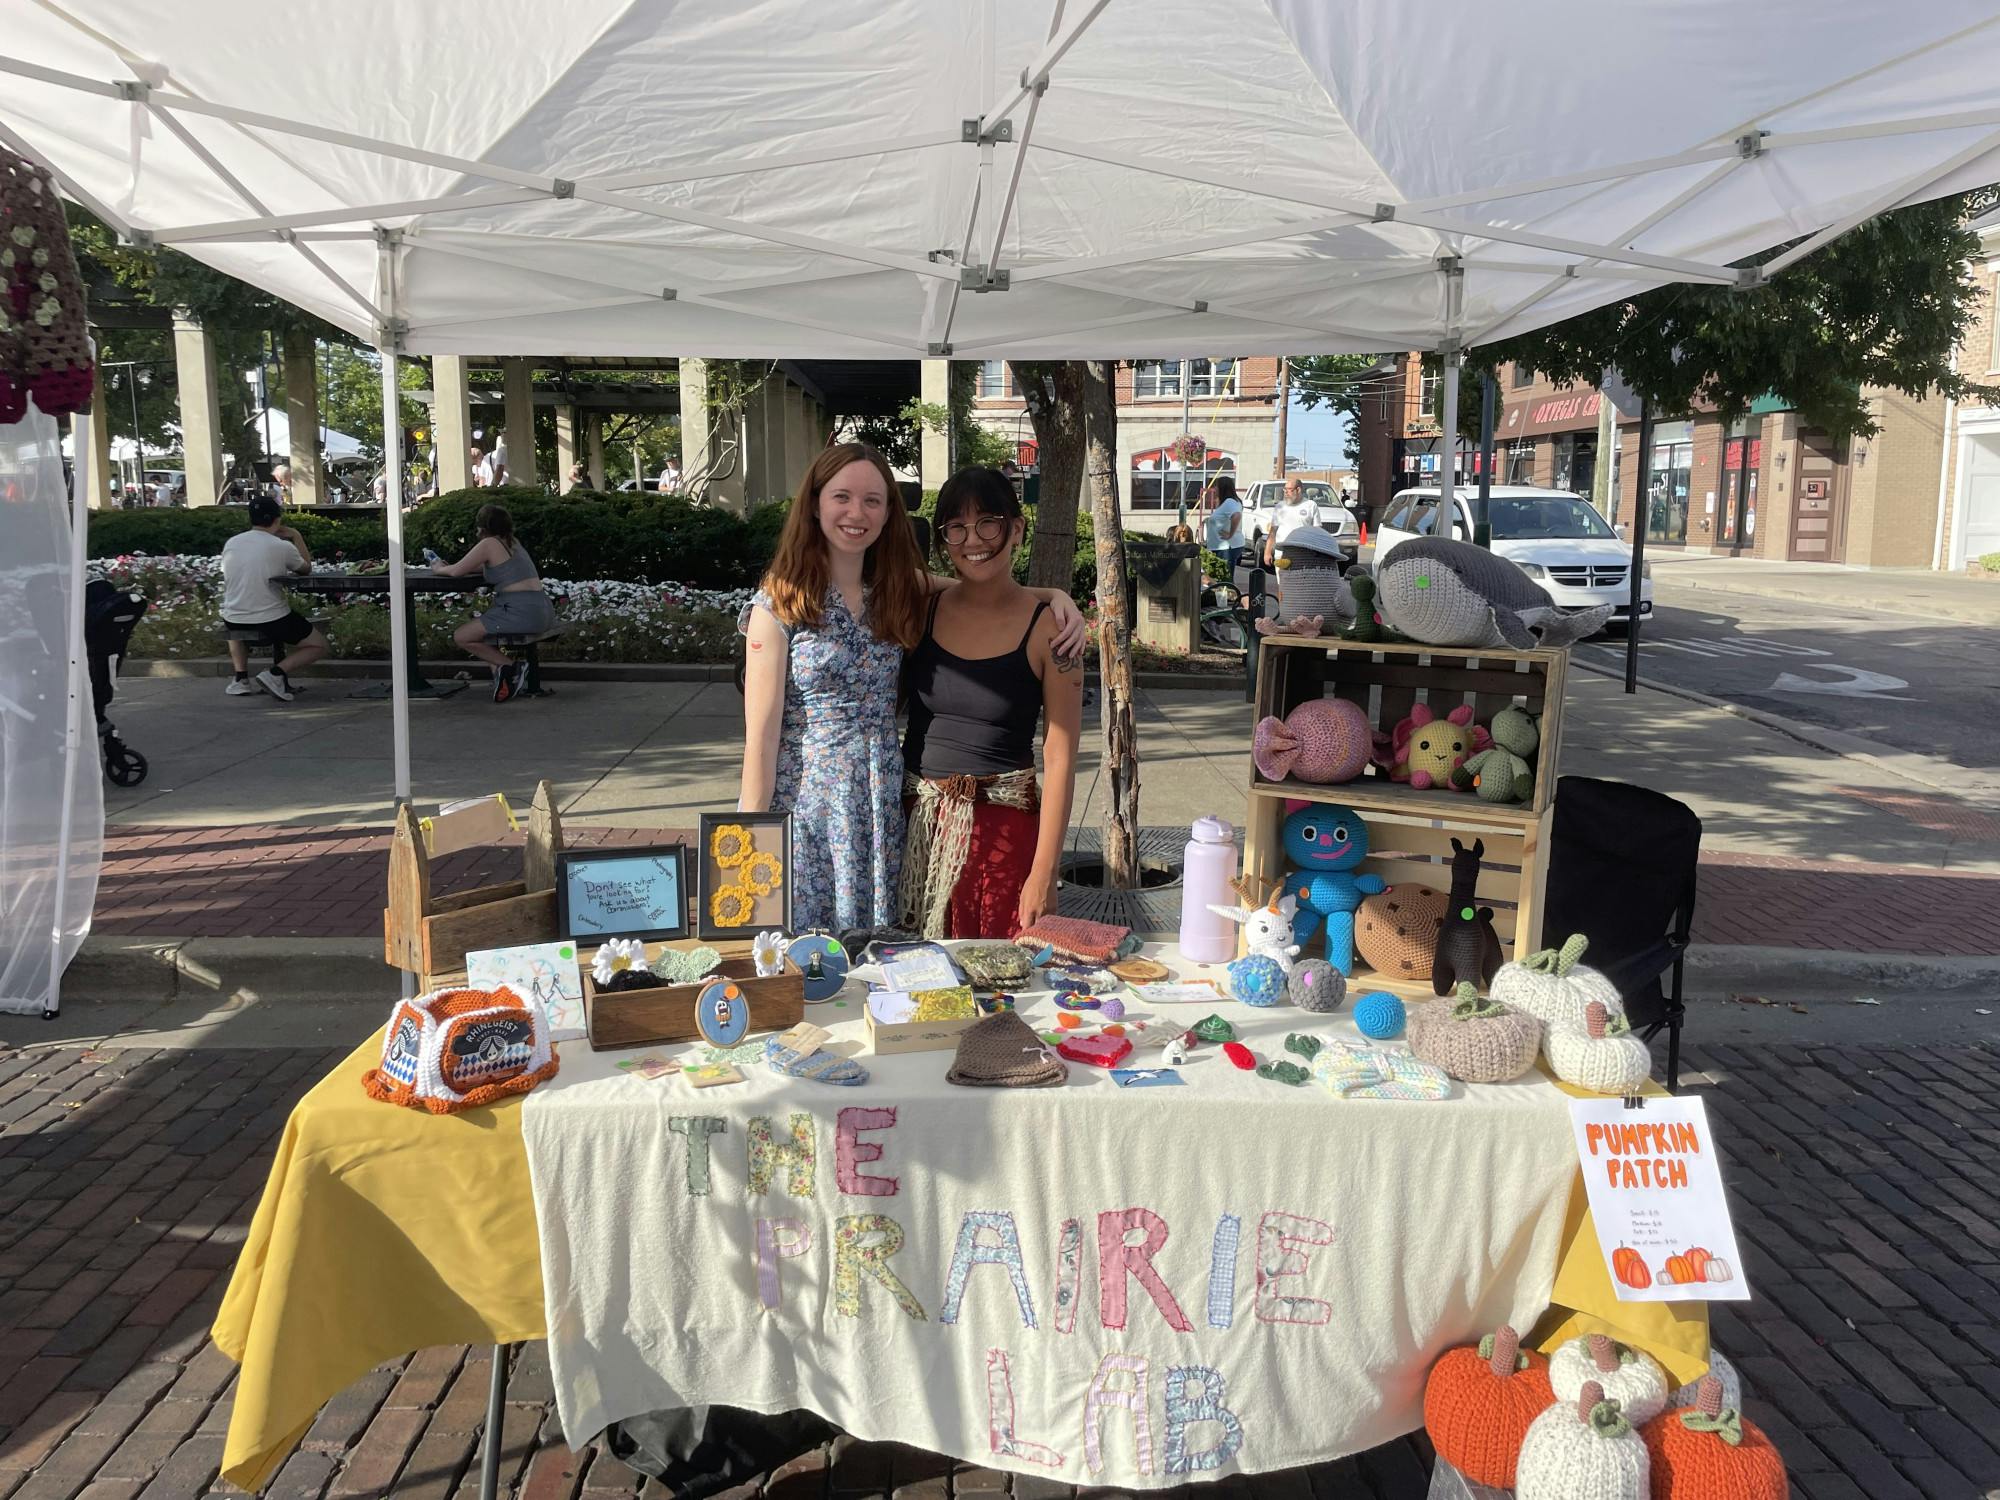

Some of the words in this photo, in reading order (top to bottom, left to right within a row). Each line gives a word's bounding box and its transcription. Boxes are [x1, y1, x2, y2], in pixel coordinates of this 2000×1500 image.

[1535, 397, 1581, 424] OXVEGAS
[1582, 394, 1601, 417] CHI
[584, 880, 613, 893] Don't
[635, 875, 656, 886] what
[466, 1019, 518, 1043] RHINEGEIST
[668, 1106, 900, 1198] THE
[1585, 1122, 1700, 1155] PUMPKIN
[1606, 1158, 1687, 1188] PATCH
[753, 1207, 1334, 1334] PRAIRIE
[987, 1348, 1245, 1476] LAB
